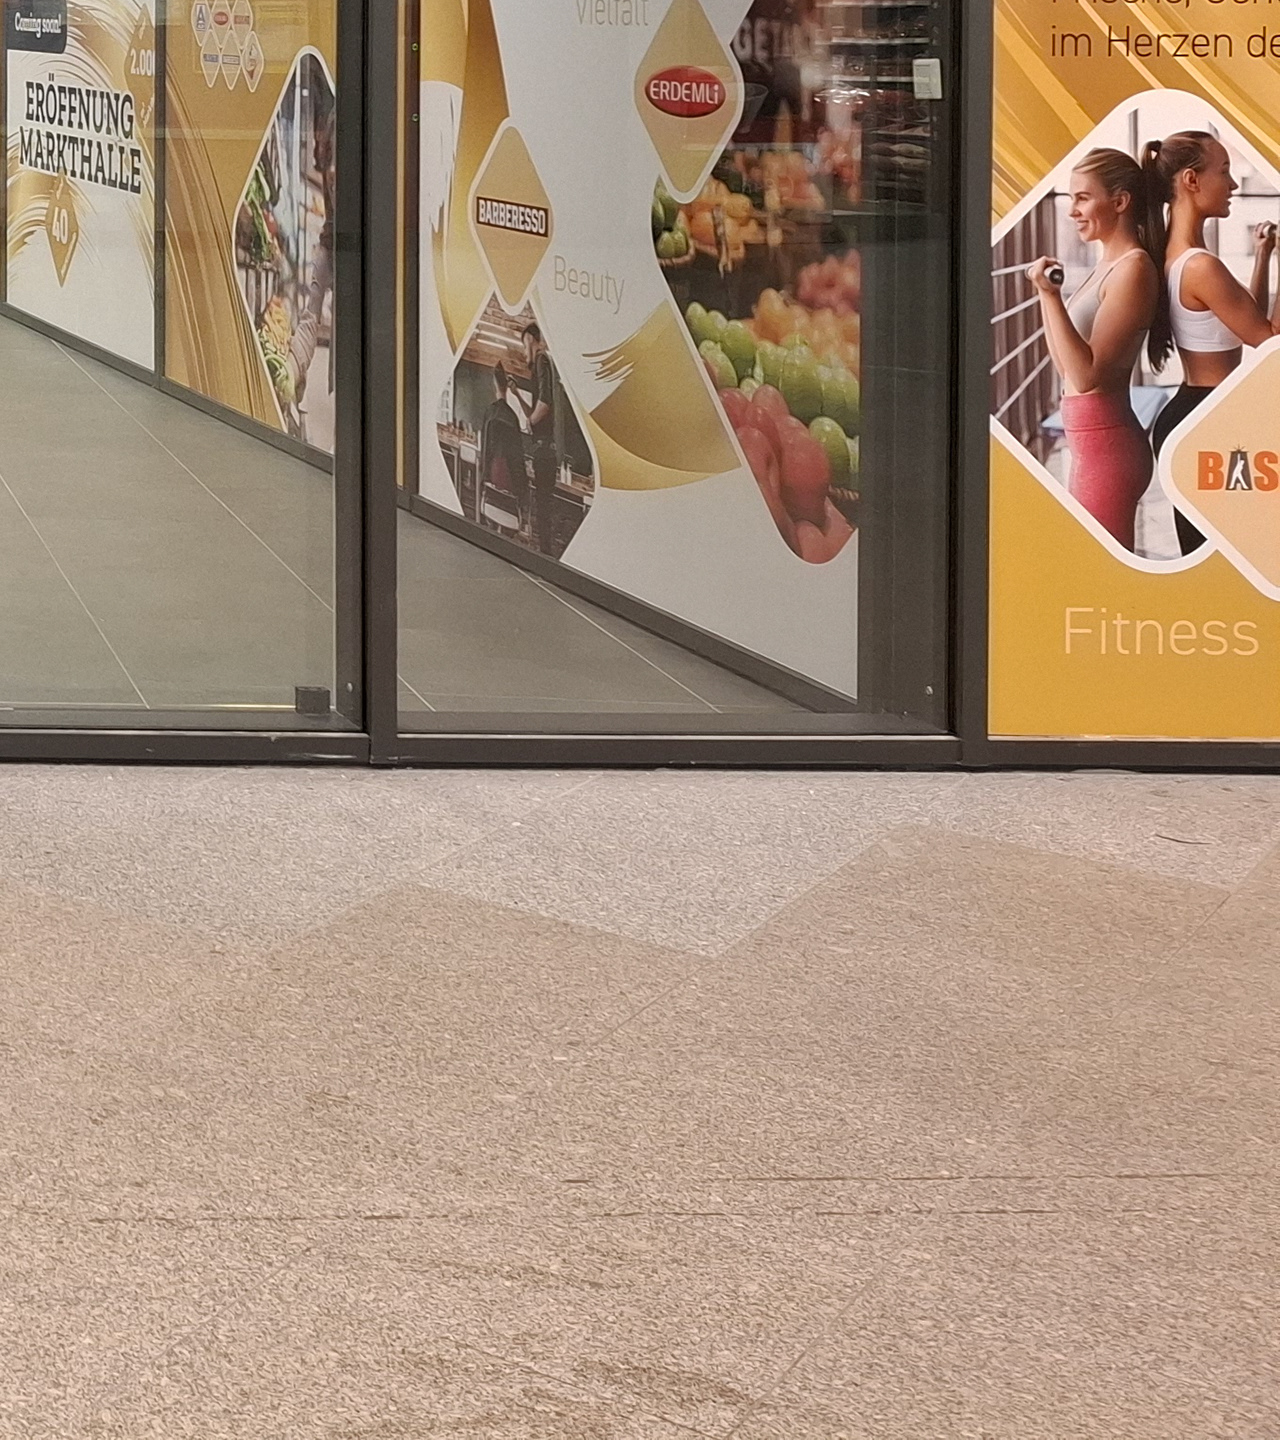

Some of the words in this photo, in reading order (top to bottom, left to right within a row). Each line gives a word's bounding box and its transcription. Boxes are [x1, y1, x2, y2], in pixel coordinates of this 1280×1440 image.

[14, 12, 42, 38] Coming
[42, 14, 62, 34] soon!
[1051, 25, 1092, 57] im
[1107, 26, 1233, 58] Herzen
[25, 73, 135, 140] ERÖFFNUNG
[19, 125, 141, 194] MARKTHALLE
[52, 206, 69, 245] 40
[478, 198, 547, 235] BARBERESSO
[554, 255, 625, 315] Beauty
[1064, 607, 1260, 656] Fitness
